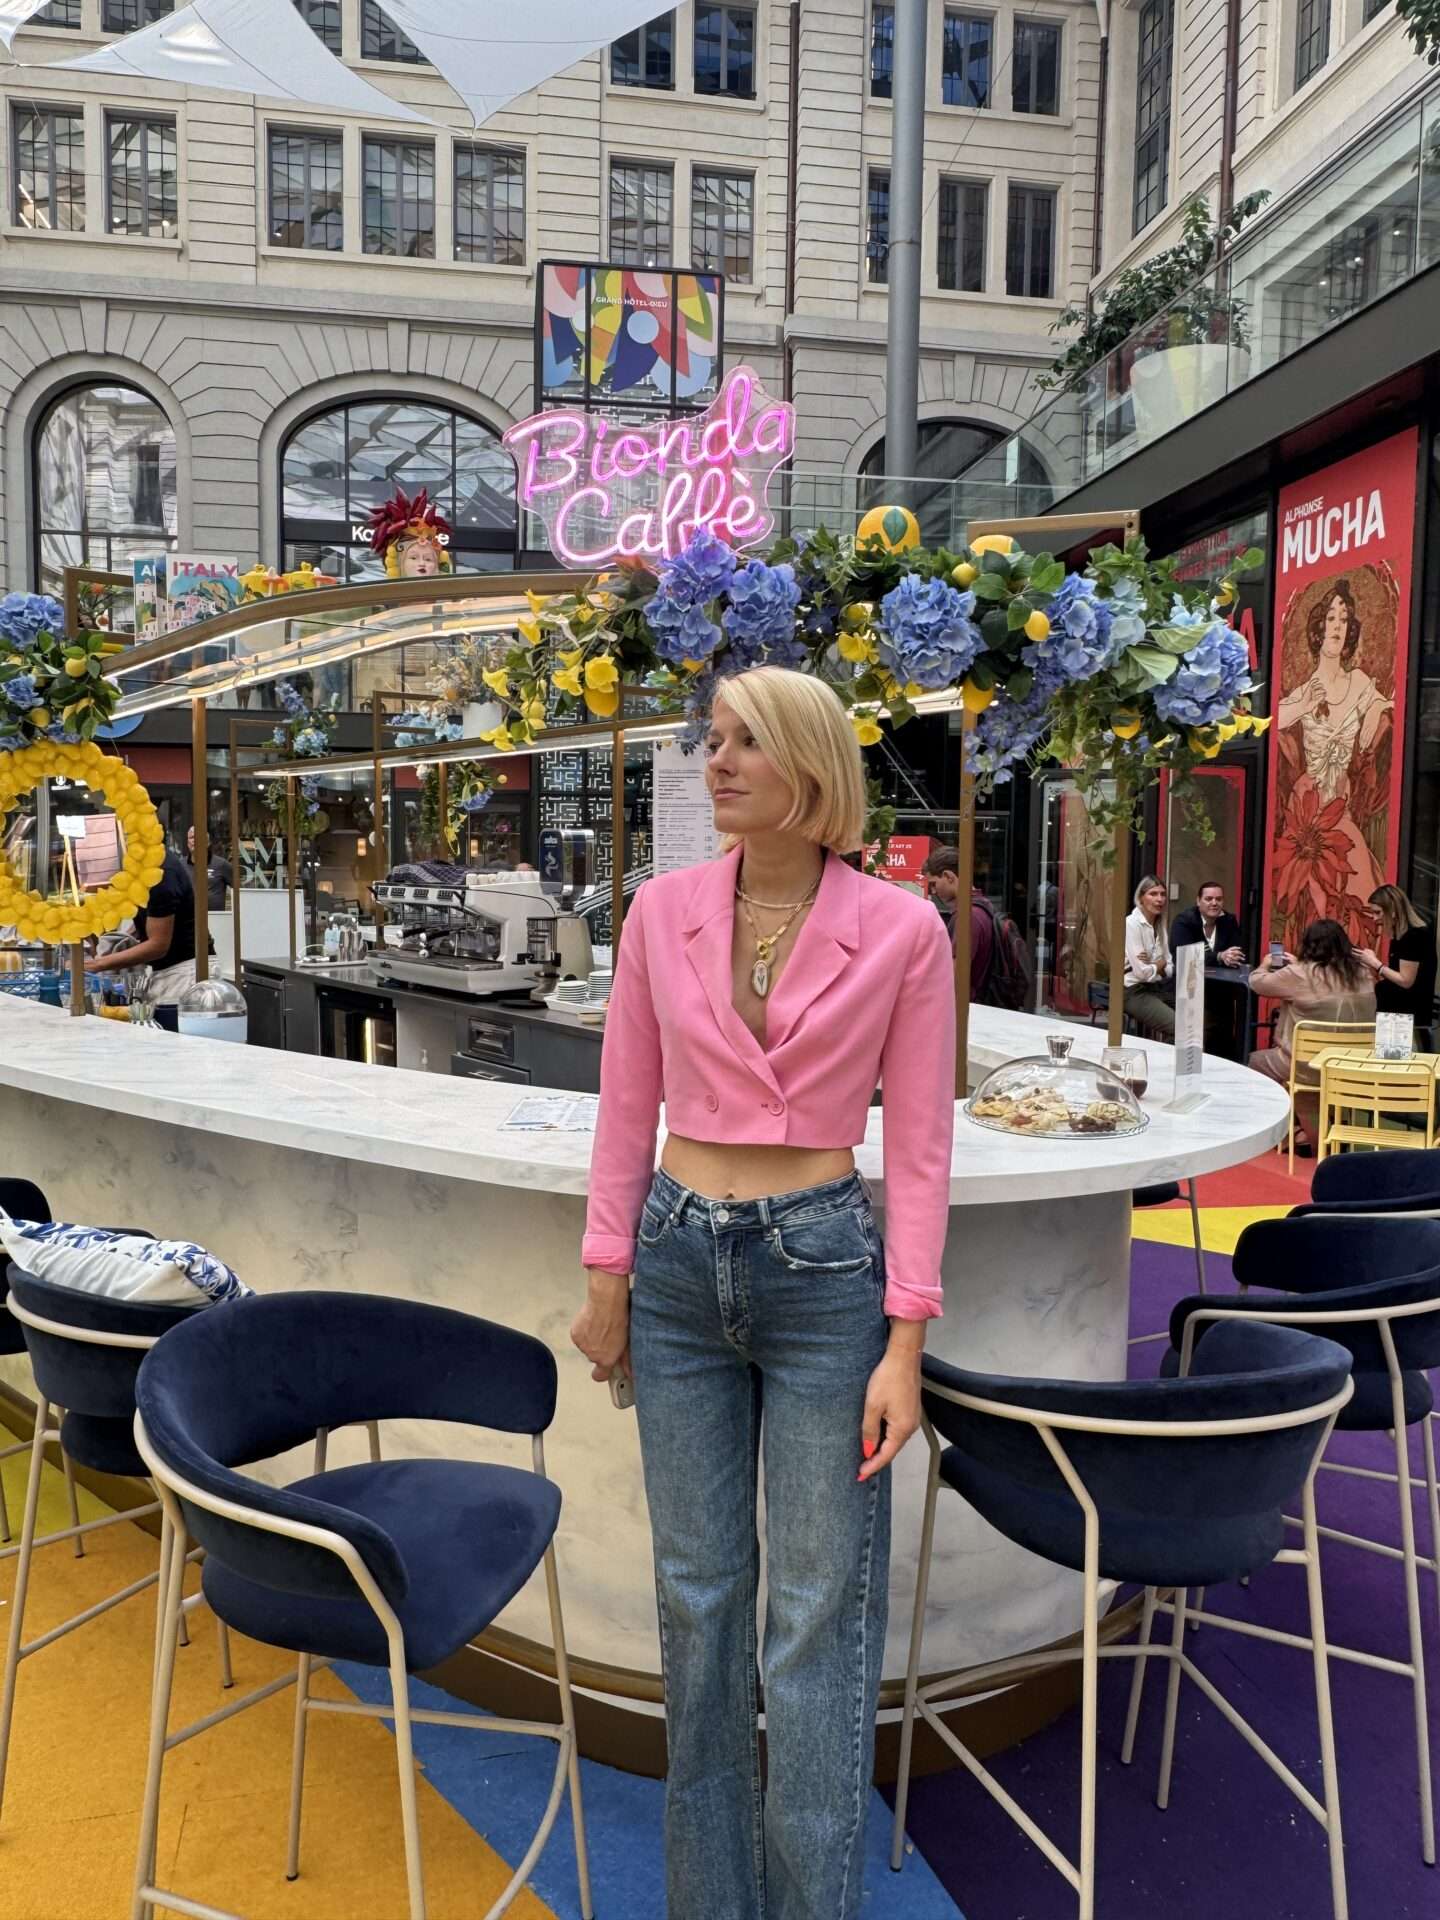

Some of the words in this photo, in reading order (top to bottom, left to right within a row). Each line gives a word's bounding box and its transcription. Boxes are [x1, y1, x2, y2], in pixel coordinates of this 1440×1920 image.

[595, 296, 623, 305] GRAND
[508, 373, 787, 504] Bionda
[556, 466, 767, 562] Caffè
[1282, 489, 1386, 574] MUCHA
[1284, 496, 1324, 525] ALPHONSE
[173, 561, 238, 578] ITALY
